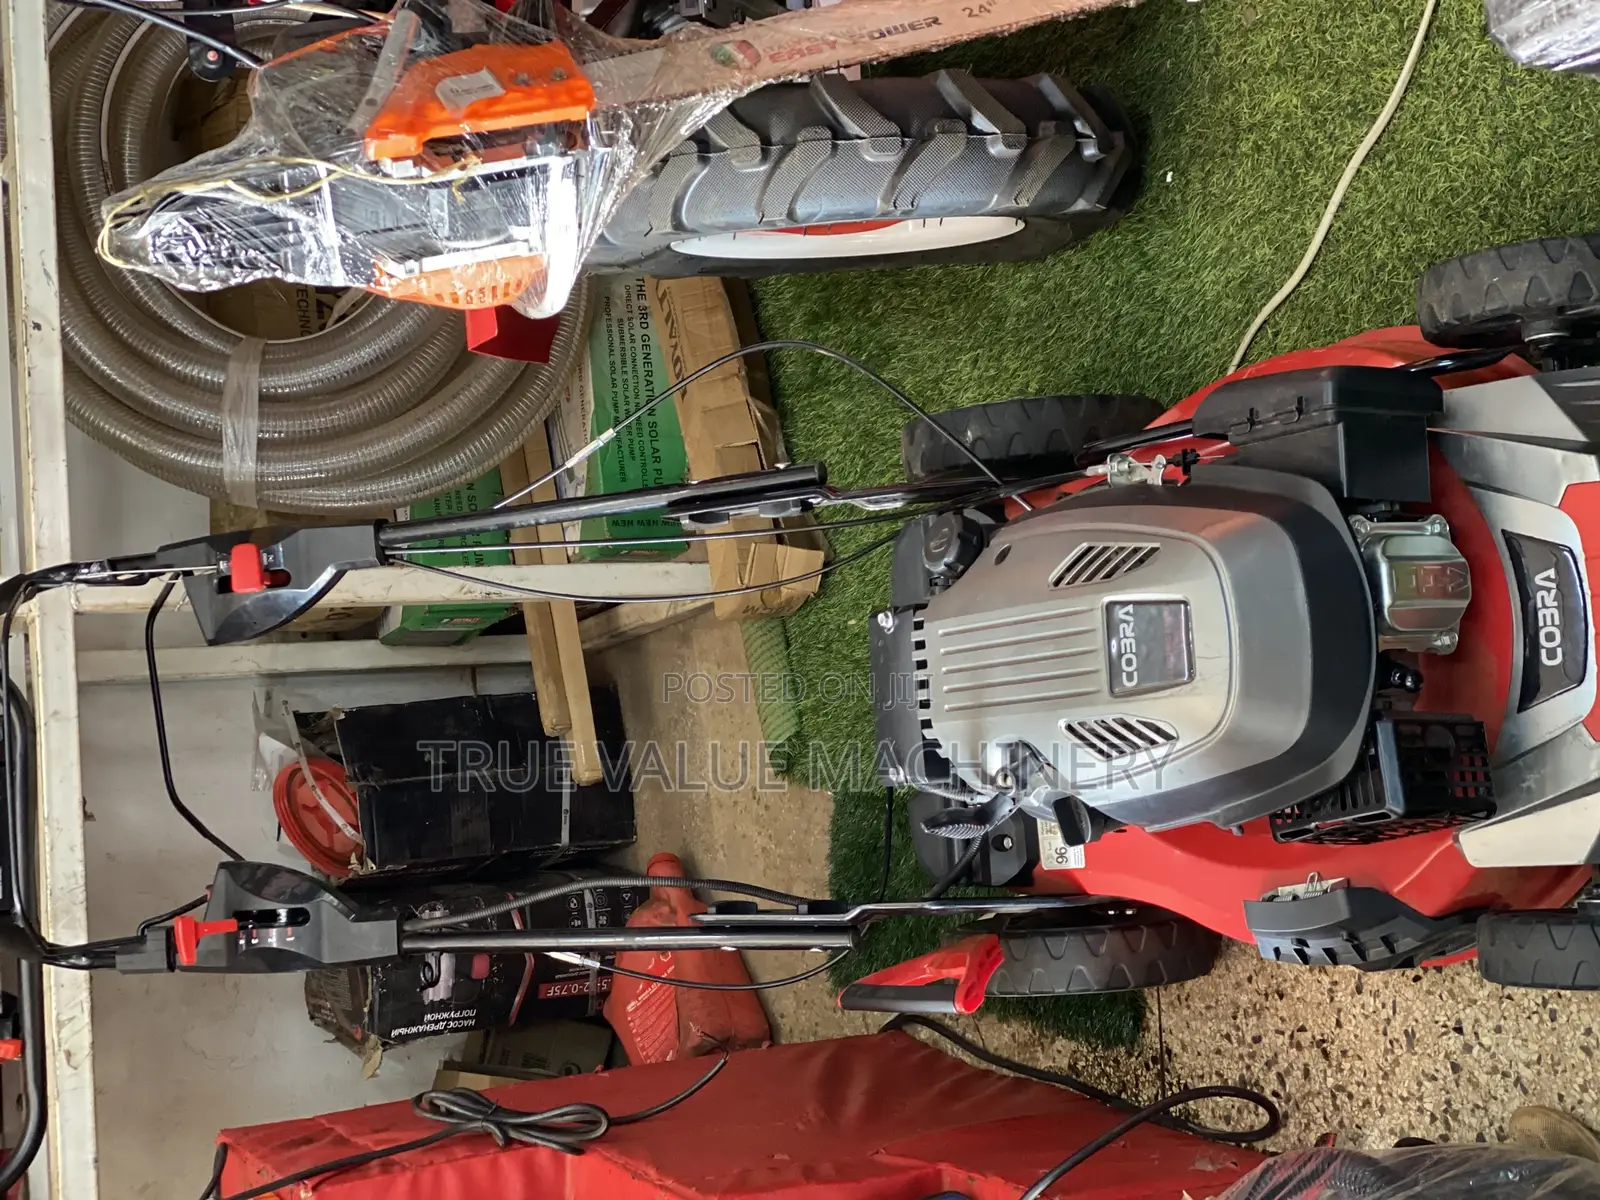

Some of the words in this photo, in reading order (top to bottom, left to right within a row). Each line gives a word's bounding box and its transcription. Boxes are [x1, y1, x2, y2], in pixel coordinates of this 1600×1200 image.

[624, 284, 633, 314] DIRECT
[636, 277, 647, 301] THE
[604, 296, 616, 358] PROFESSIONAL
[627, 317, 636, 344] SOLAR
[638, 305, 649, 330] 3RD
[616, 318, 628, 375] SUBMERSIBLE
[608, 361, 618, 388] SOLAR
[630, 347, 641, 401] CONNECTION
[611, 391, 620, 412] PUMP
[621, 378, 631, 406] SOLAR
[628, 438, 636, 461] PUMP
[648, 420, 661, 464] SOLAR
[611, 519, 634, 527] NEW
[637, 519, 658, 527] NEW
[1534, 567, 1563, 666] COBRA
[1118, 604, 1138, 687] COBRA
[1055, 846, 1068, 864] 96
[424, 1009, 477, 1022] ПОГРУЖНОЙ
[447, 1019, 475, 1028] НАСОС
[391, 1021, 447, 1038] ДРЕНАЖНЫЙ
